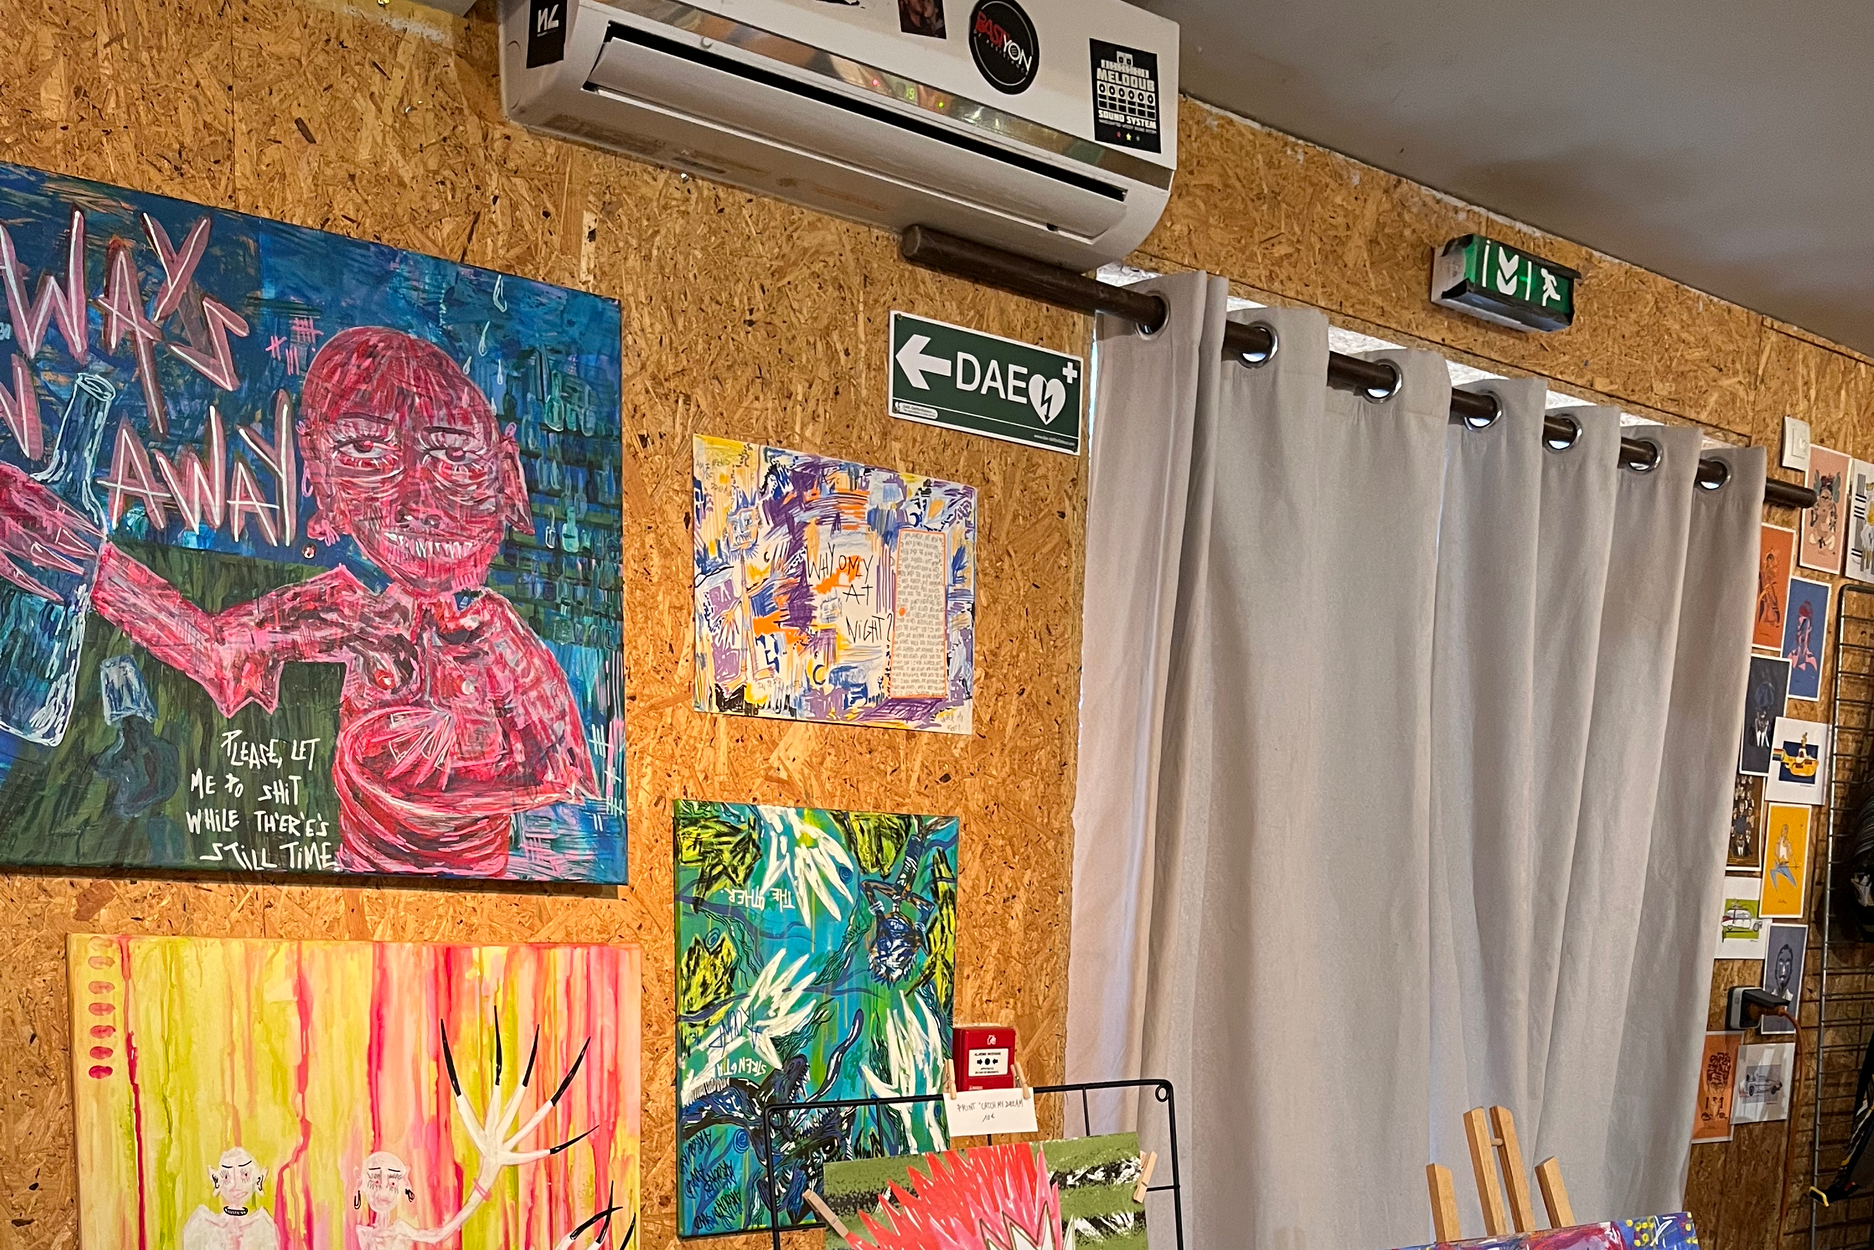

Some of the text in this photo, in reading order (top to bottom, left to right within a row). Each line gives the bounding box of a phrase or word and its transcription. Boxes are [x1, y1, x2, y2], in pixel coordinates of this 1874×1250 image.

[1126, 115, 1157, 130] SYSTEM
[956, 351, 1028, 404] DAE
[95, 388, 297, 547] AWAY
[806, 542, 836, 581] WHY
[842, 583, 873, 606] AT
[846, 613, 894, 643] NIGHT?
[291, 738, 321, 771] LET
[190, 768, 217, 799] ME
[258, 775, 302, 806] SHIT
[186, 808, 240, 835] WHILE
[199, 842, 278, 871] STILL
